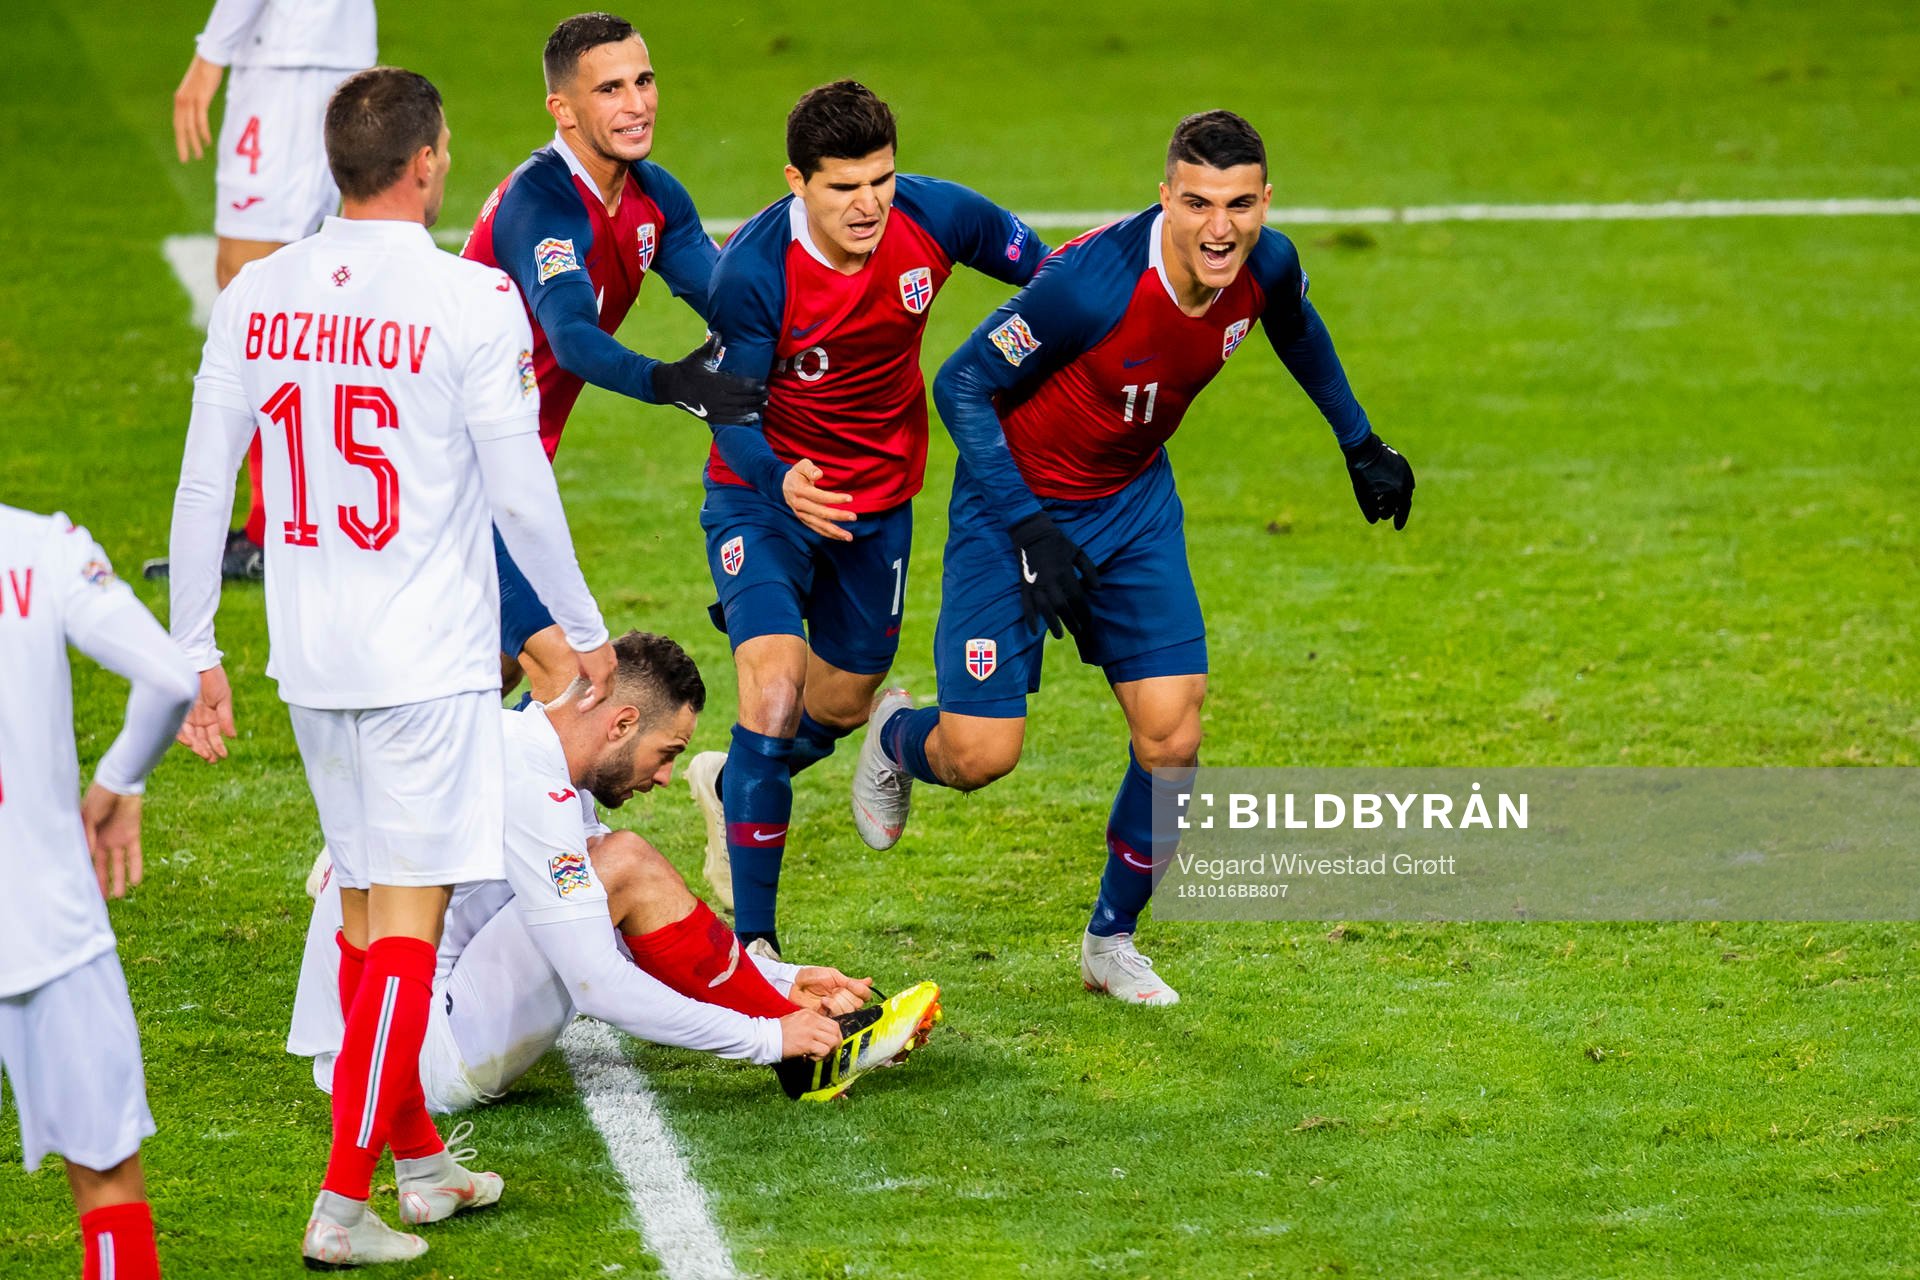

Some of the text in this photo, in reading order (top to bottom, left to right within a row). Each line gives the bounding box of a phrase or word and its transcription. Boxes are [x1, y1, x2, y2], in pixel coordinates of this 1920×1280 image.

[235, 115, 262, 175] 4
[245, 312, 432, 374] BOZHIKOV
[1121, 382, 1159, 424] 11
[260, 382, 400, 551] 15
